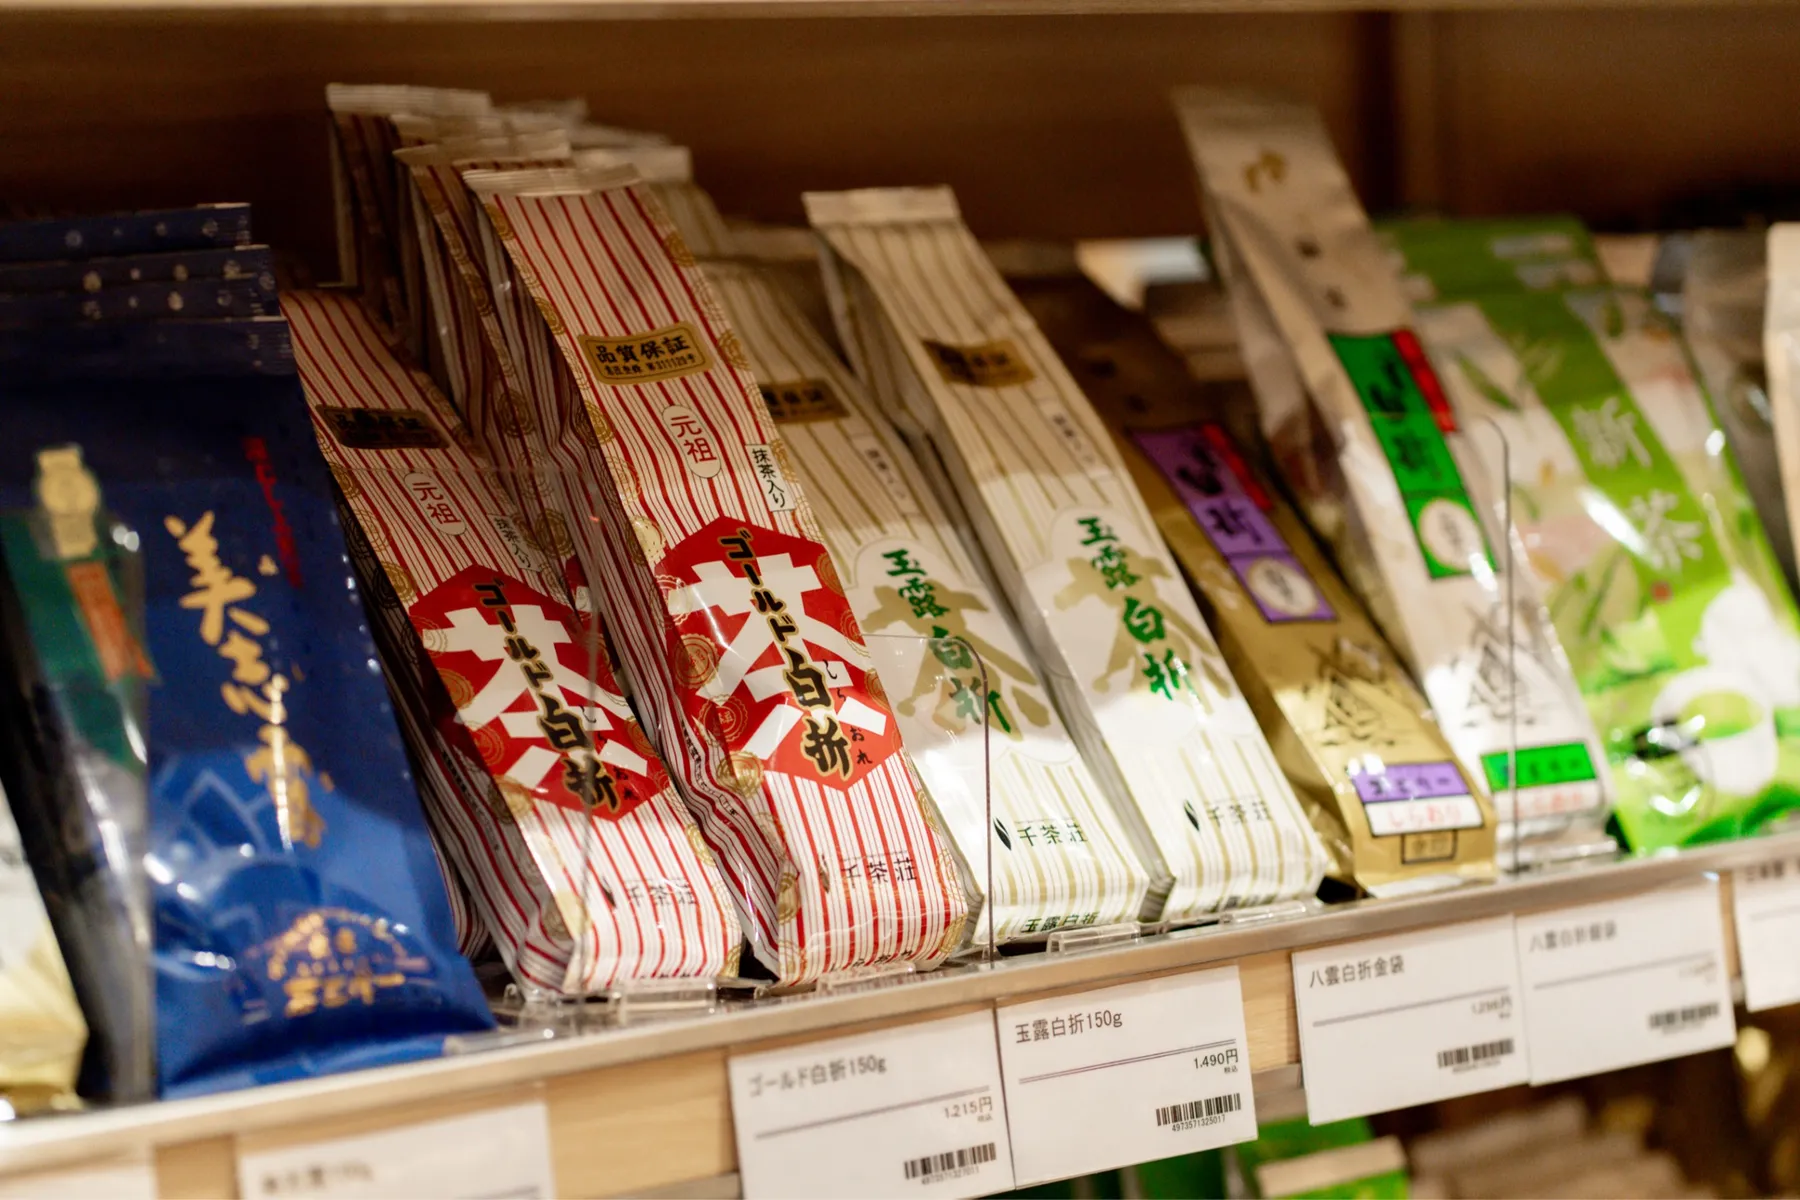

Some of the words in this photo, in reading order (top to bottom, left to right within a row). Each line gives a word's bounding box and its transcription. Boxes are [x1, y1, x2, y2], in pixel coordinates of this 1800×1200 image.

[596, 335, 690, 363] 品質保証
[670, 415, 717, 464] 元祖
[751, 448, 787, 508] 抹茶入り
[412, 482, 461, 524] 元祖
[1077, 517, 1200, 702] 玉露白折
[718, 527, 853, 777] ゴールド白折
[883, 549, 1011, 734] 玉露白折
[475, 577, 619, 812] ゴールド白折
[822, 659, 873, 765] しらおれ
[840, 857, 917, 889] 千茶荘
[1310, 955, 1404, 988] 八雲白折金袋
[1015, 1010, 1123, 1044] 玉露白折150g
[748, 1054, 887, 1097] ゴールド白折150g
[1172, 1114, 1226, 1132] 4973571325017
